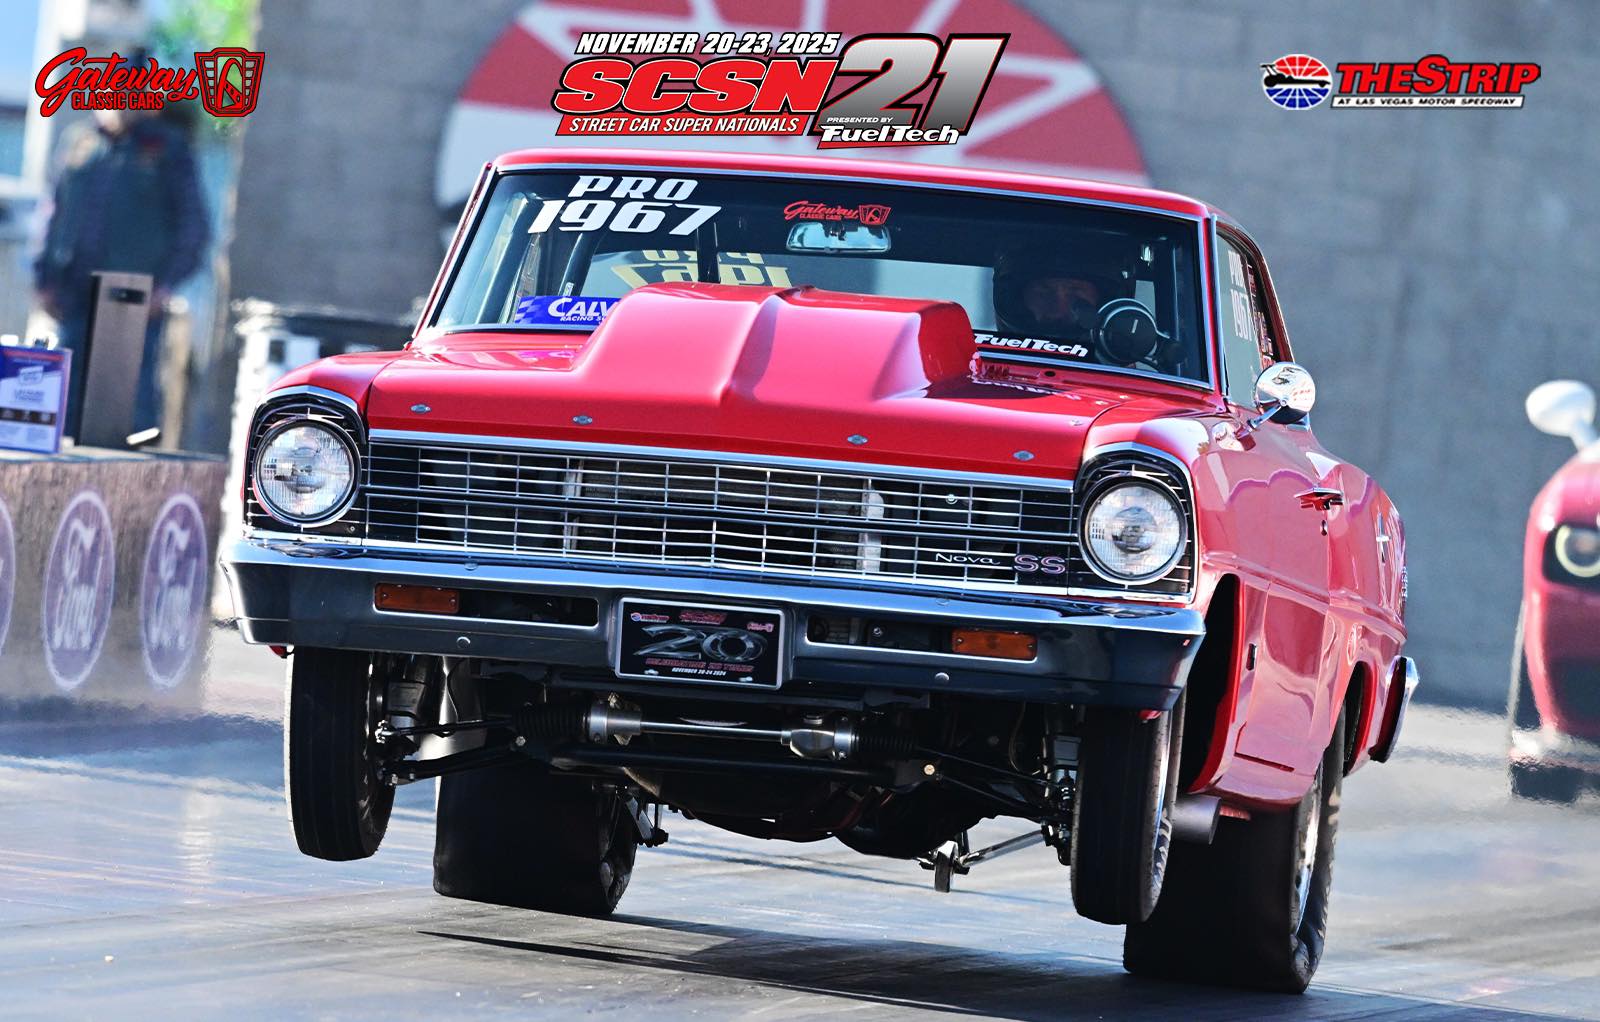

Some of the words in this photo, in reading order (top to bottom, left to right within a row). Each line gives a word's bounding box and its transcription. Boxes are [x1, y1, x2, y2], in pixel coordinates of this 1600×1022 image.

[567, 175, 699, 201] PRO
[527, 199, 722, 236] 1967
[783, 200, 859, 221] Gateway
[974, 333, 1089, 358] FuelTech
[935, 552, 1001, 566] Nova
[1013, 554, 1066, 575] SS
[633, 624, 769, 662] 20
